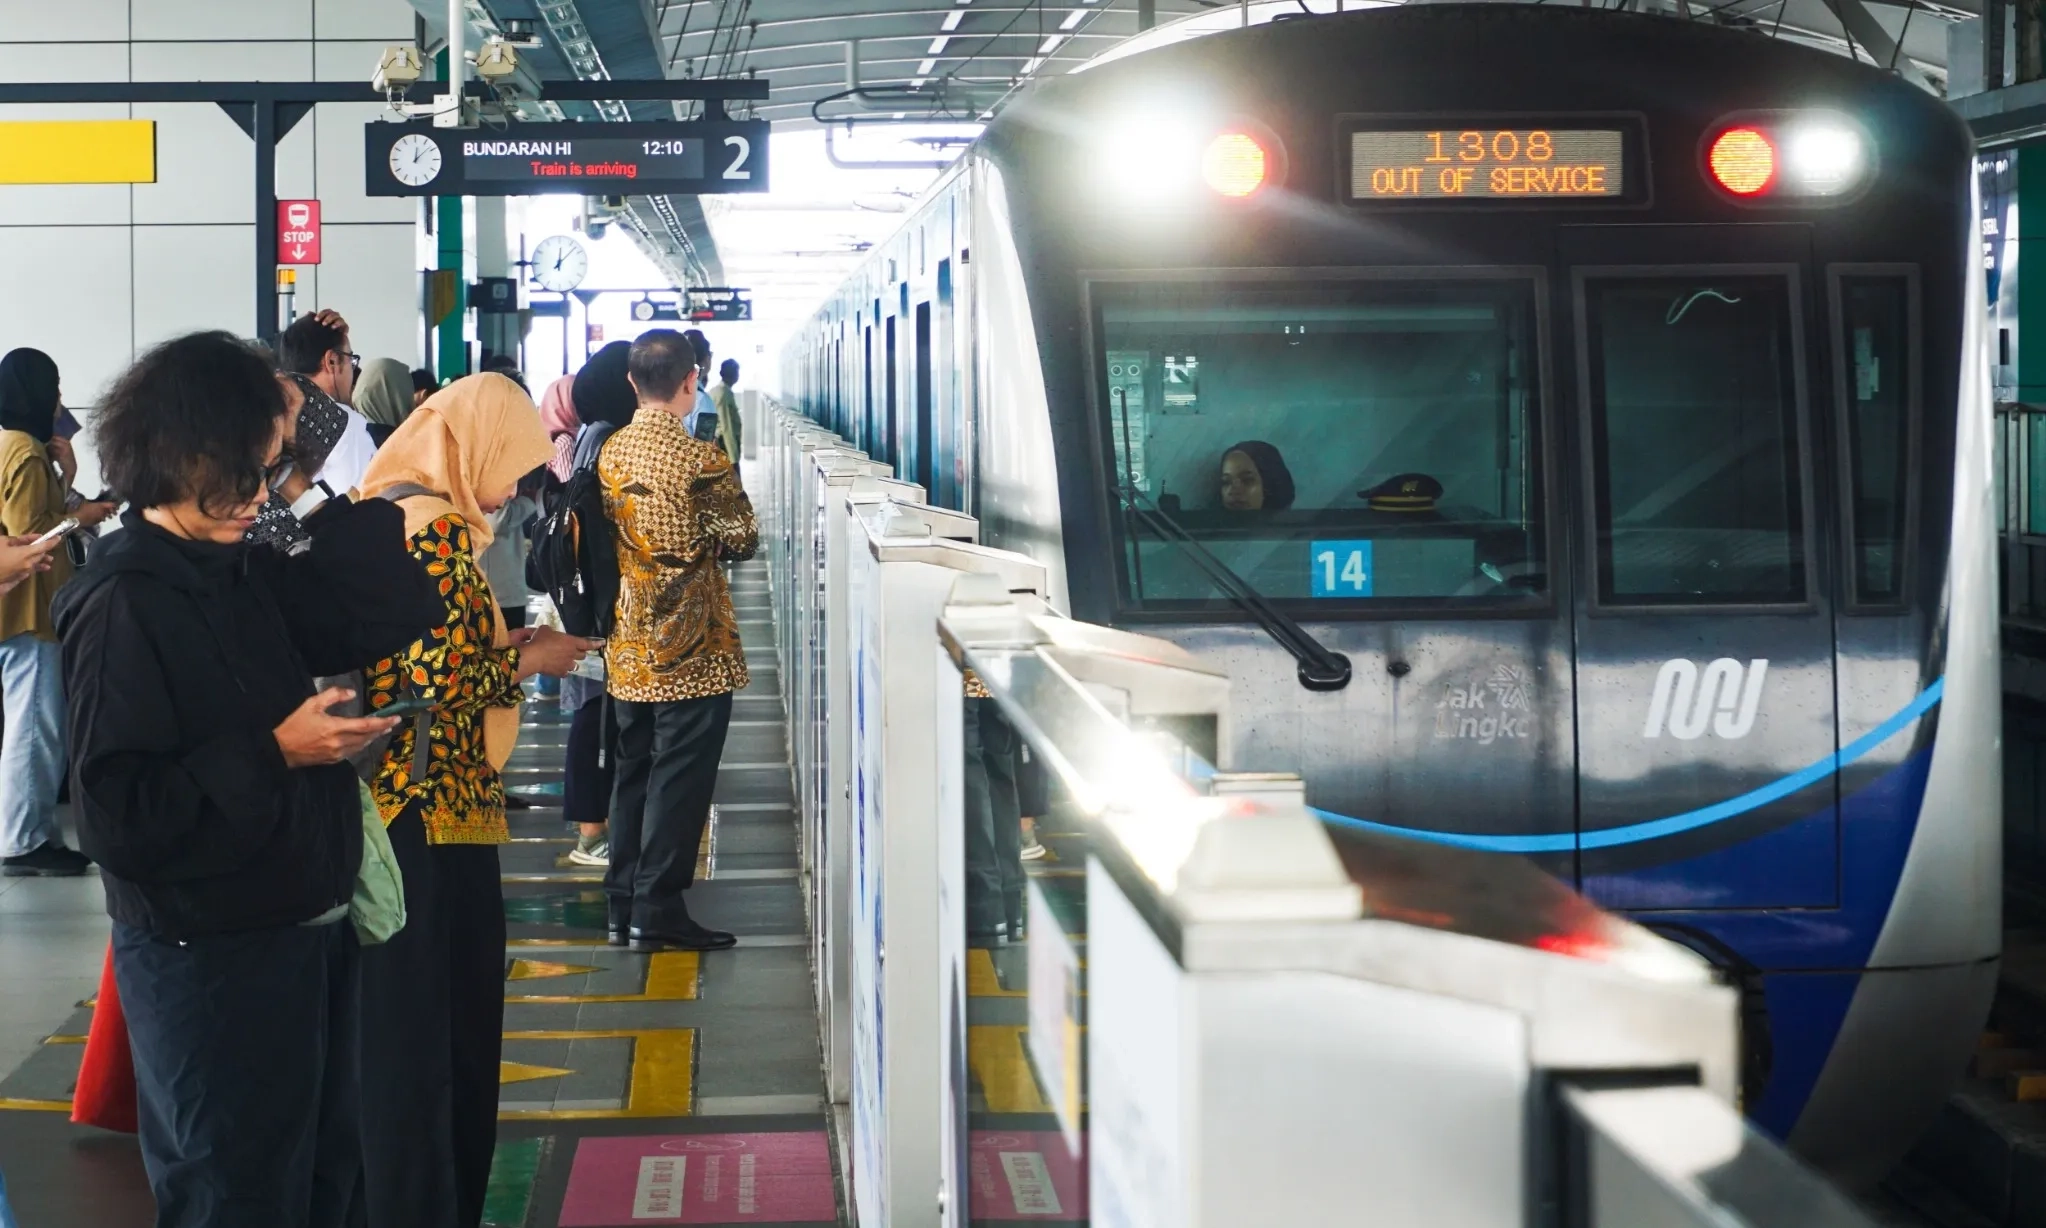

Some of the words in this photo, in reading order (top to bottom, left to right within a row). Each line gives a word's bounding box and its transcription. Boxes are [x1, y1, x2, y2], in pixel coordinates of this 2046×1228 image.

[463, 142, 552, 156] BUNDARAN
[555, 142, 572, 156] HI
[642, 141, 684, 155] 12:10
[722, 135, 751, 179] 2
[1425, 130, 1553, 162] 1308
[531, 161, 567, 176] Train
[569, 161, 583, 176] is
[586, 161, 637, 178] arriving
[1371, 167, 1424, 194] OUT
[1439, 167, 1475, 194] OF
[1490, 166, 1606, 194] SERVICE
[283, 231, 315, 243] STOP
[738, 304, 748, 318] 2
[1317, 549, 1367, 591] 14
